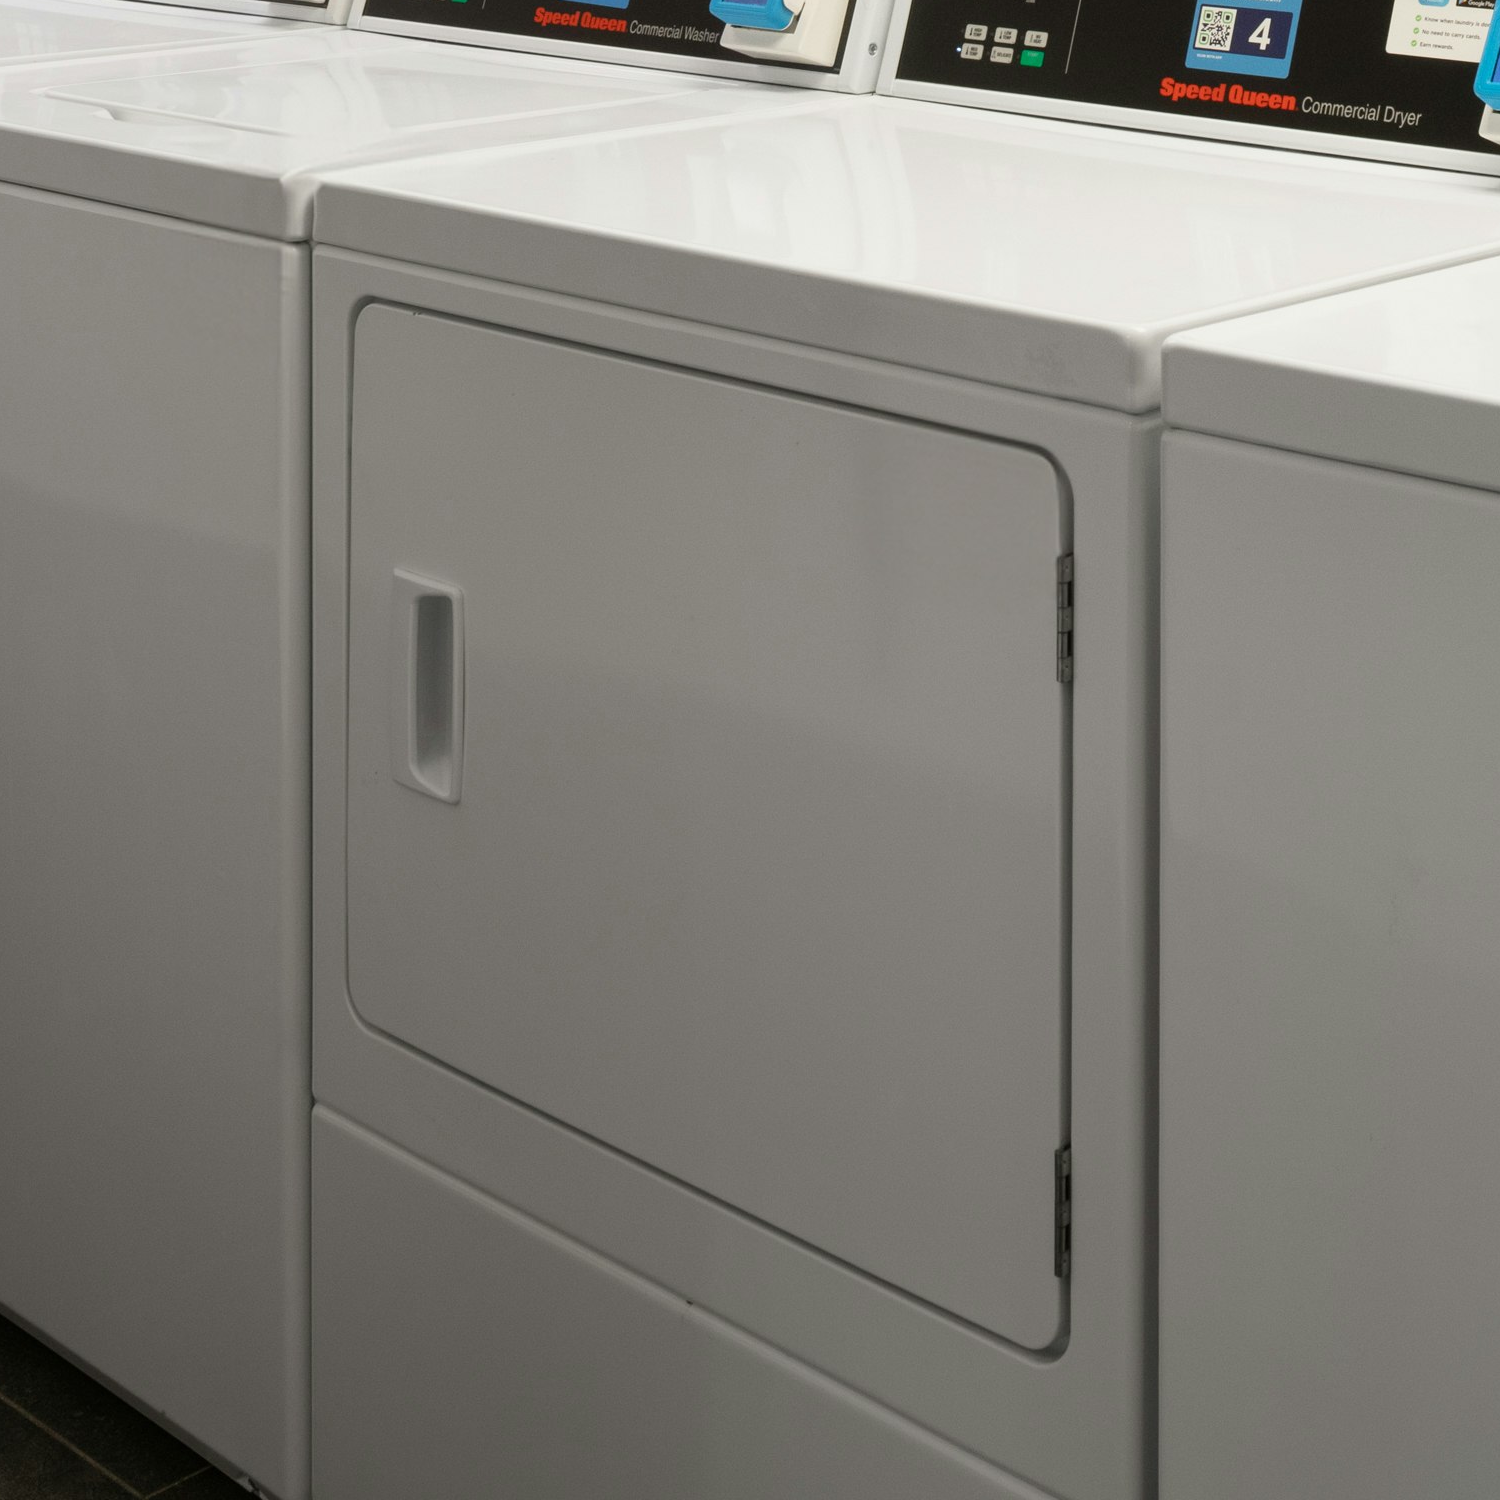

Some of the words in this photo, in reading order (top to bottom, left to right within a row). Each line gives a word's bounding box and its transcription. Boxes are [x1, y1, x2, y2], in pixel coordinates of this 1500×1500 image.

[534, 7, 580, 26] Speed
[581, 12, 627, 32] Queen
[629, 20, 682, 39] Commercial
[684, 26, 720, 43] Washer
[1248, 18, 1271, 50] 4
[1160, 77, 1226, 102] Speed
[1229, 84, 1297, 111] Queen
[1301, 96, 1380, 121] Commercial
[1384, 106, 1422, 128] Dryer
